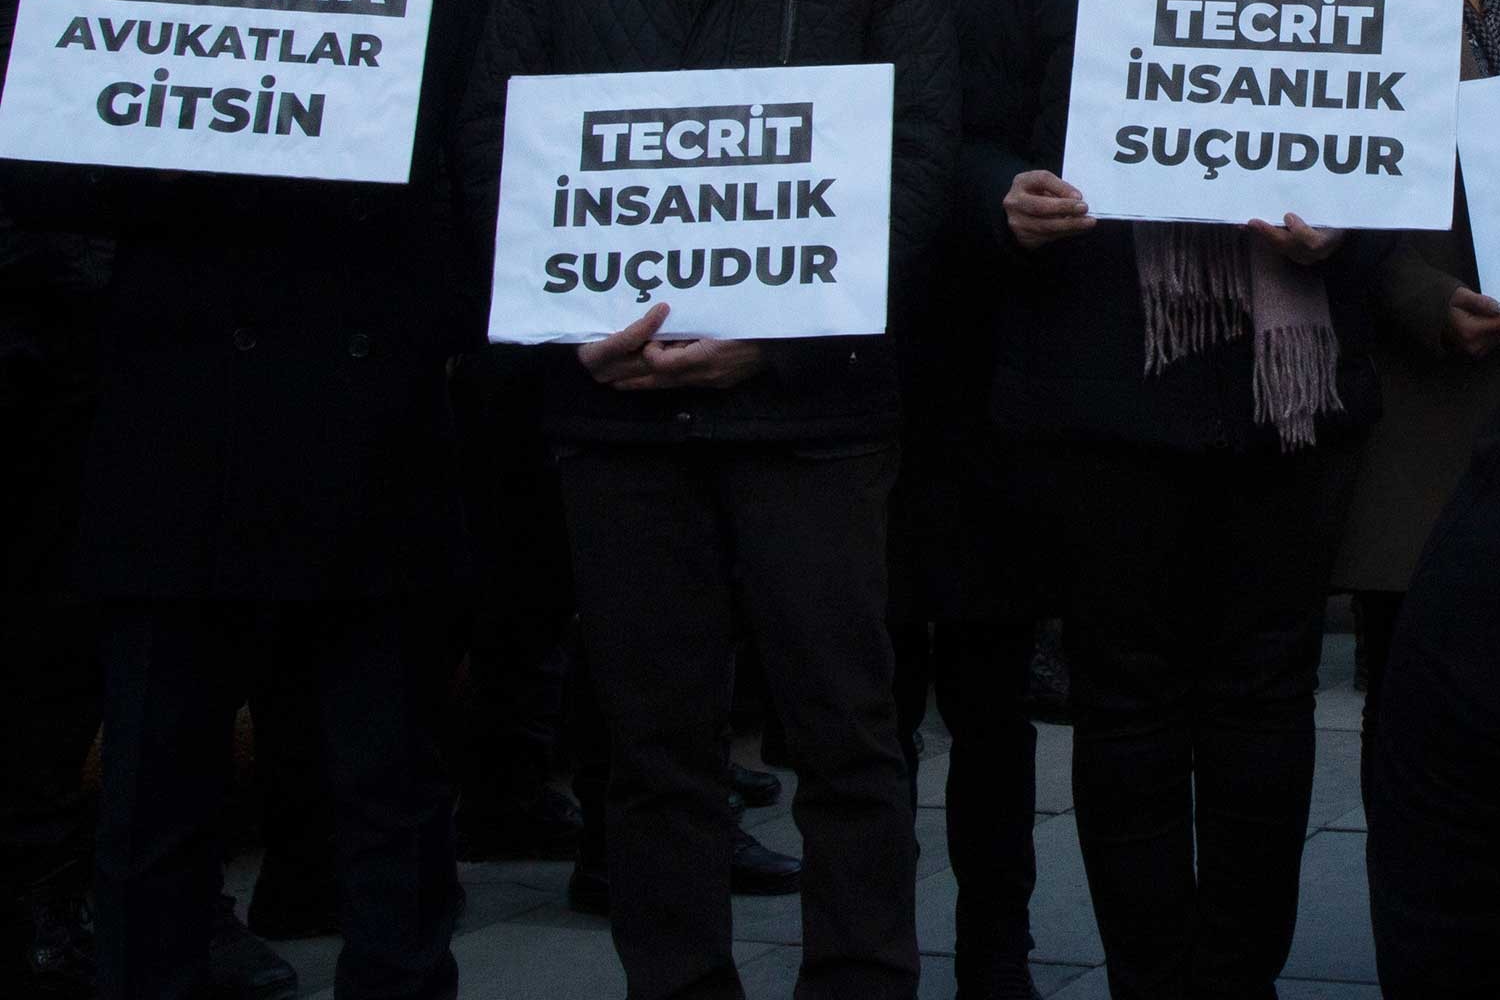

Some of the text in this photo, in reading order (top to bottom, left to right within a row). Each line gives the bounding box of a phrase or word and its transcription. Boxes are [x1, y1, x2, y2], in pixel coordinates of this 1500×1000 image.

[56, 16, 383, 68] AVUKATLAR
[96, 67, 326, 137] GİTSİN
[1125, 47, 1407, 111] İNSANLIK
[592, 104, 803, 163] TECRİT
[1113, 125, 1406, 180] SUÇUDUR
[553, 174, 837, 227] İNSANLIK
[543, 244, 838, 303] SUÇUDUR
